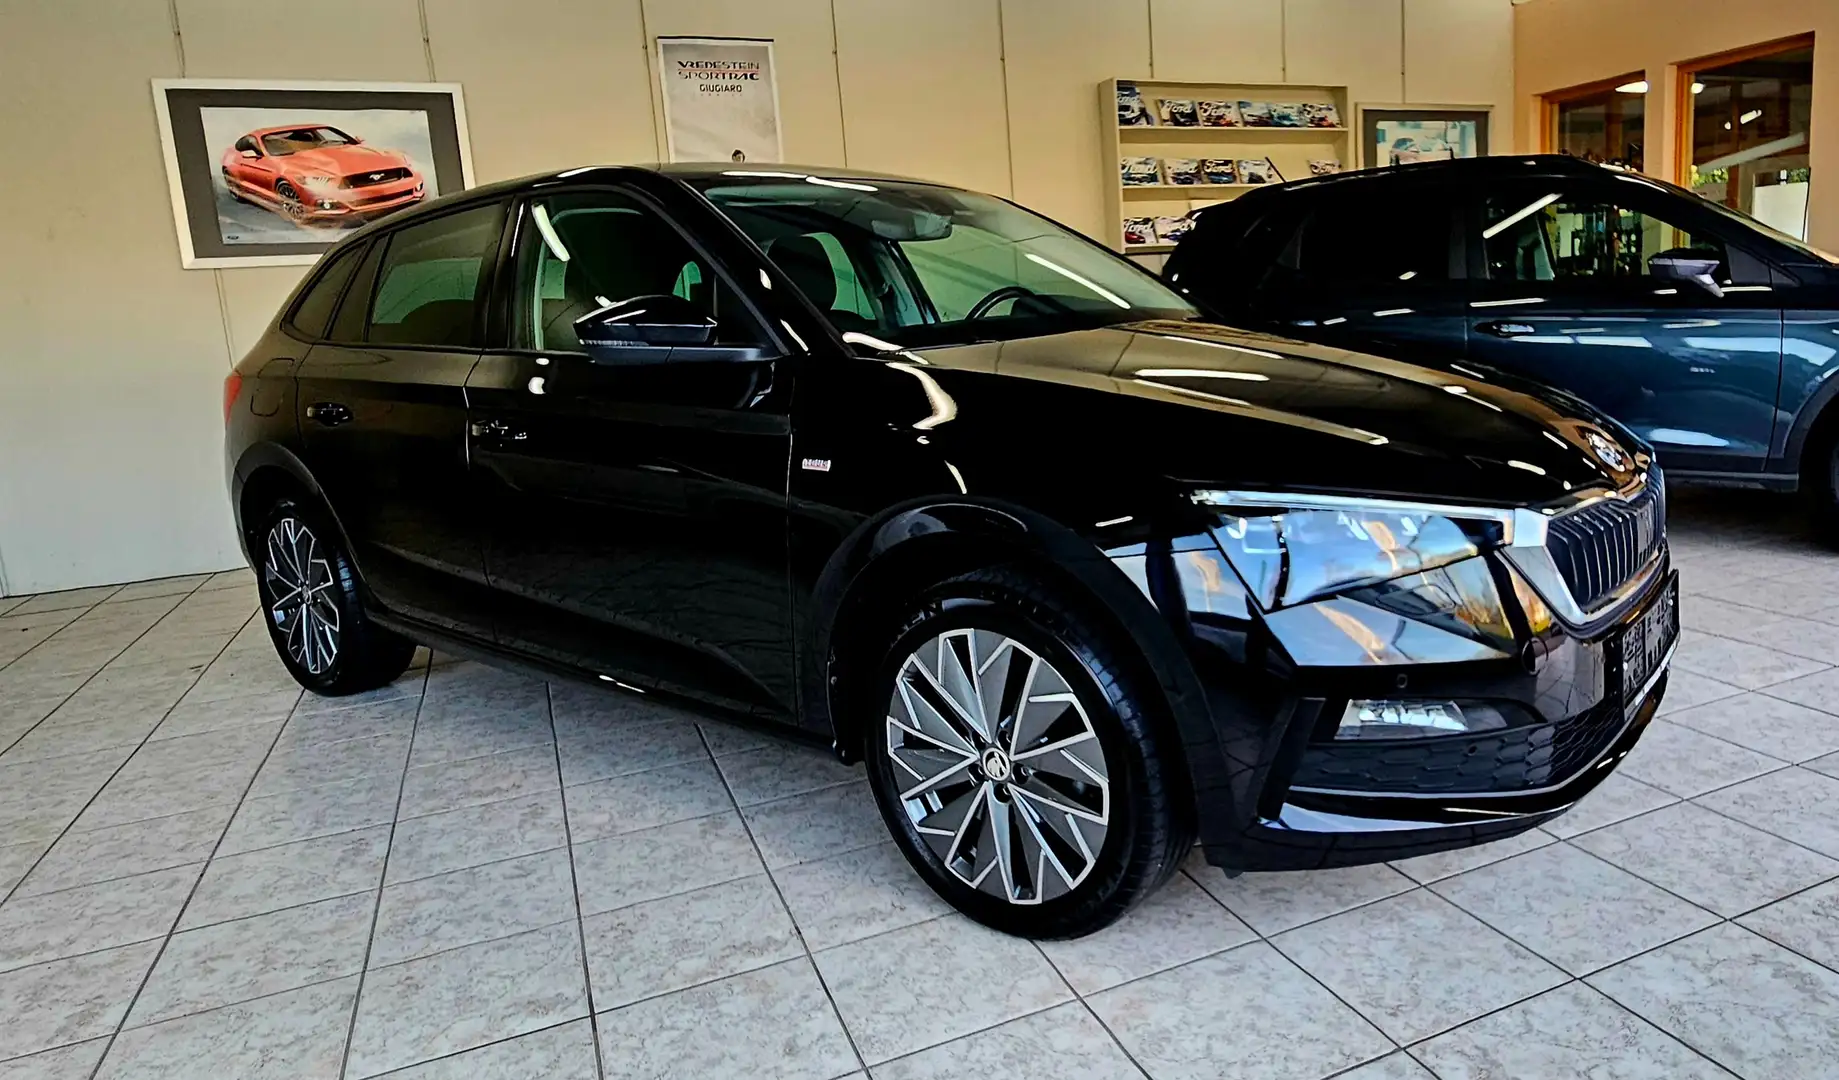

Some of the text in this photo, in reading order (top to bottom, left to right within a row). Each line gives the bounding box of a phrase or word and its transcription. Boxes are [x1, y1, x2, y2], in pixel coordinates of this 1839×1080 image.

[677, 61, 760, 70] VREDESTEIN
[678, 71, 760, 80] SPORTRAC
[700, 84, 742, 92] GIUGIARO
[1163, 100, 1193, 113] Ford
